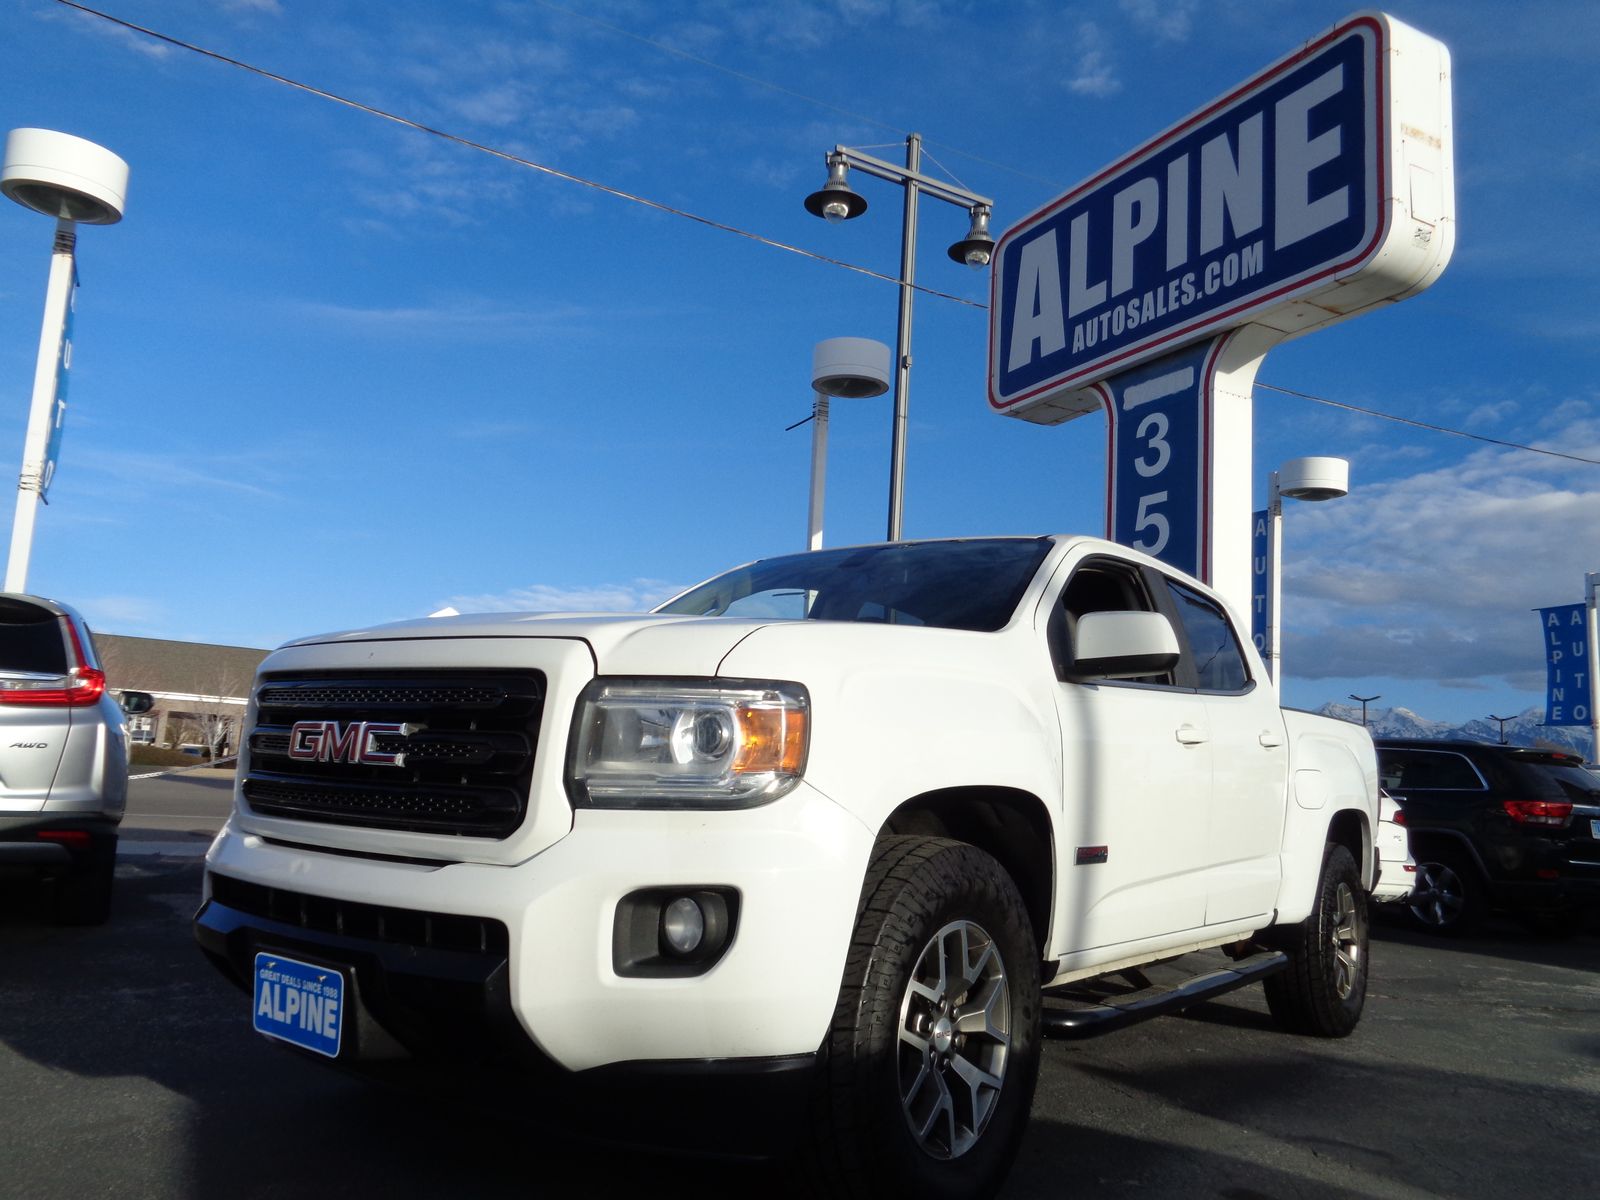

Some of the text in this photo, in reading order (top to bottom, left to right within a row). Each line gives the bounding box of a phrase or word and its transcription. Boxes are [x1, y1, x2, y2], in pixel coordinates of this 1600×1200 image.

[1008, 63, 1349, 373] ALPINE
[1072, 240, 1264, 355] AUTOSALES.COM
[1253, 518, 1267, 651] AUTO
[1548, 613, 1565, 720] ALPINE
[1571, 610, 1587, 720] AUTO
[288, 721, 408, 767] GMC
[258, 981, 338, 1040] ALPINE
[260, 968, 281, 983] GREAT
[281, 974, 302, 989] DEALS
[302, 979, 322, 994] SINCE
